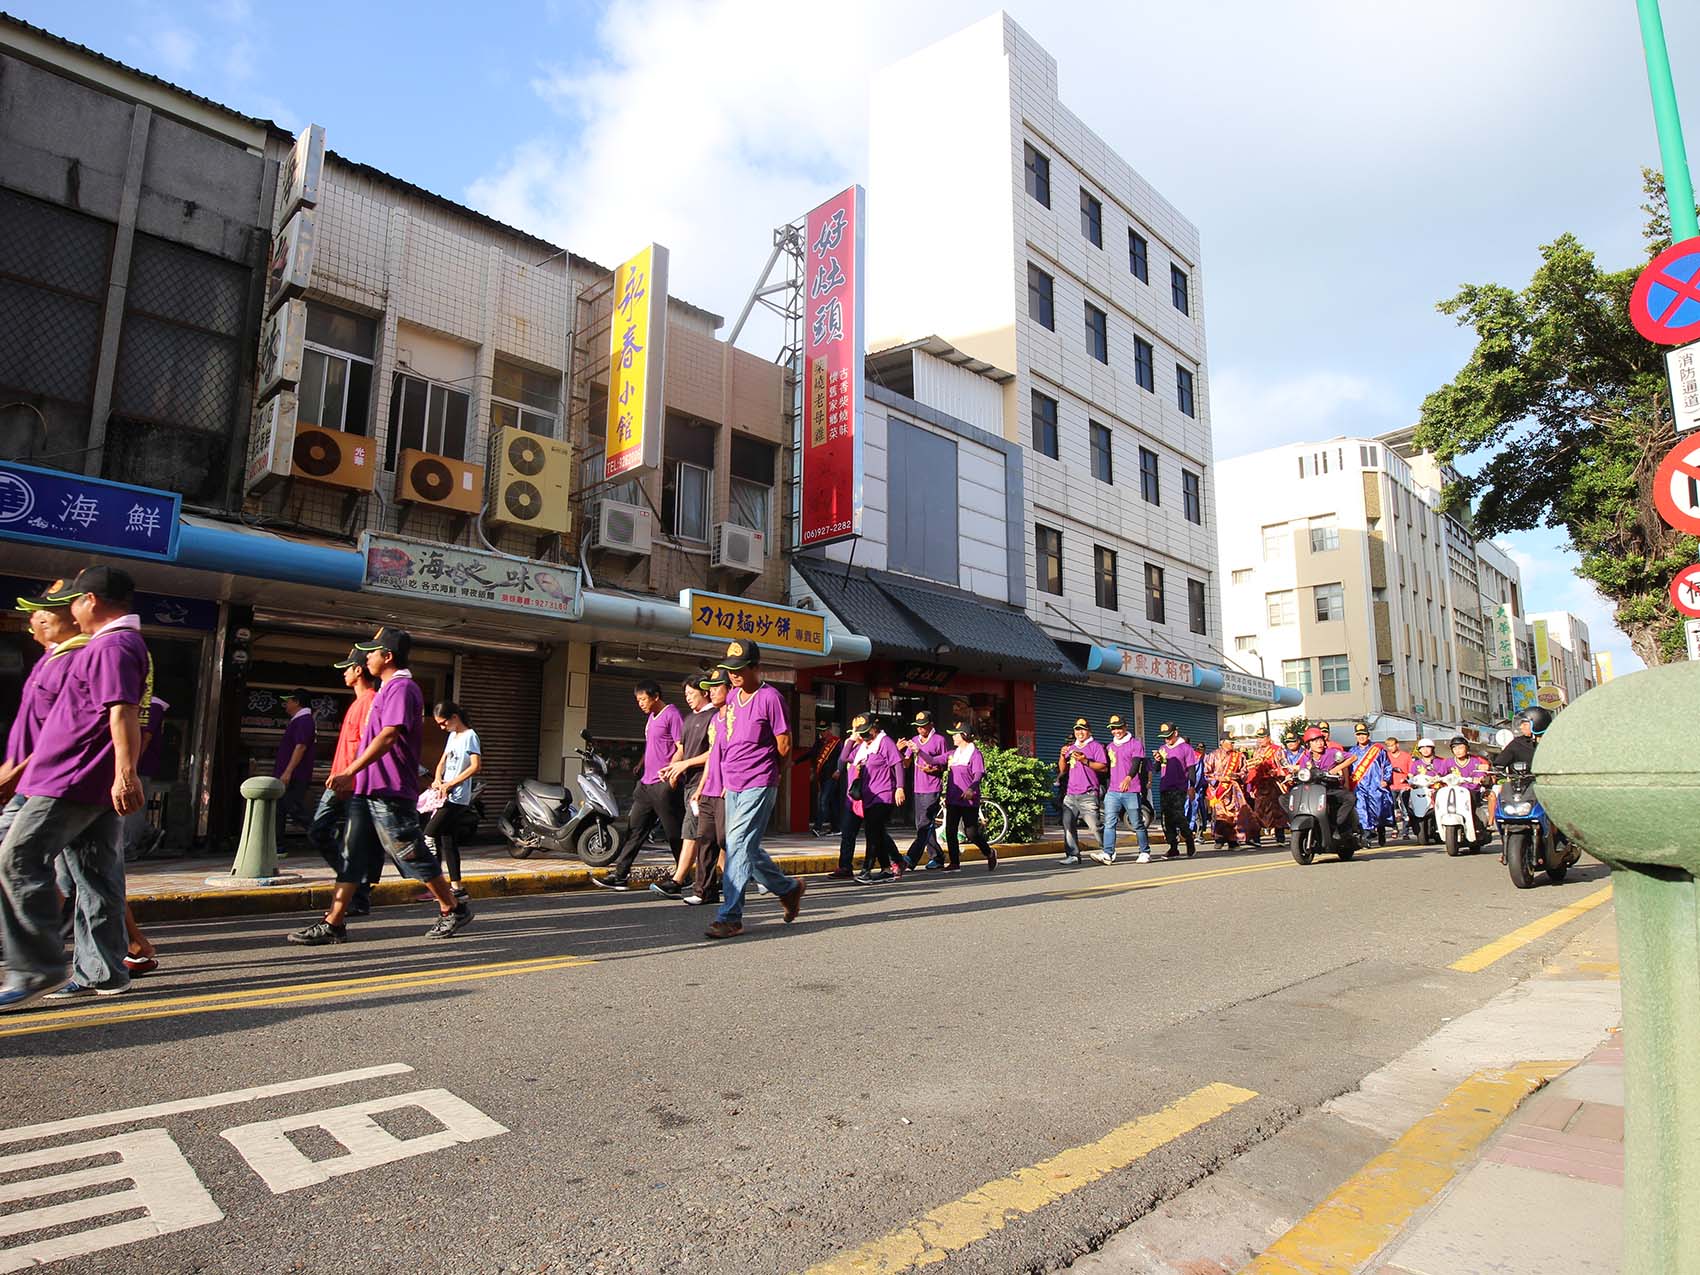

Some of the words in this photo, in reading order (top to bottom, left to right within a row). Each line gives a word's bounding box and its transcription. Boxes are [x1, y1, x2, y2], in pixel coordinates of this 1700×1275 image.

[616, 265, 645, 442] 永春小館
[58, 493, 161, 537] 海鮮
[803, 520, 852, 541] (06)927-2282
[696, 606, 791, 641] 刀切麵炒餅
[1121, 651, 1191, 683] 中興皮箱行
